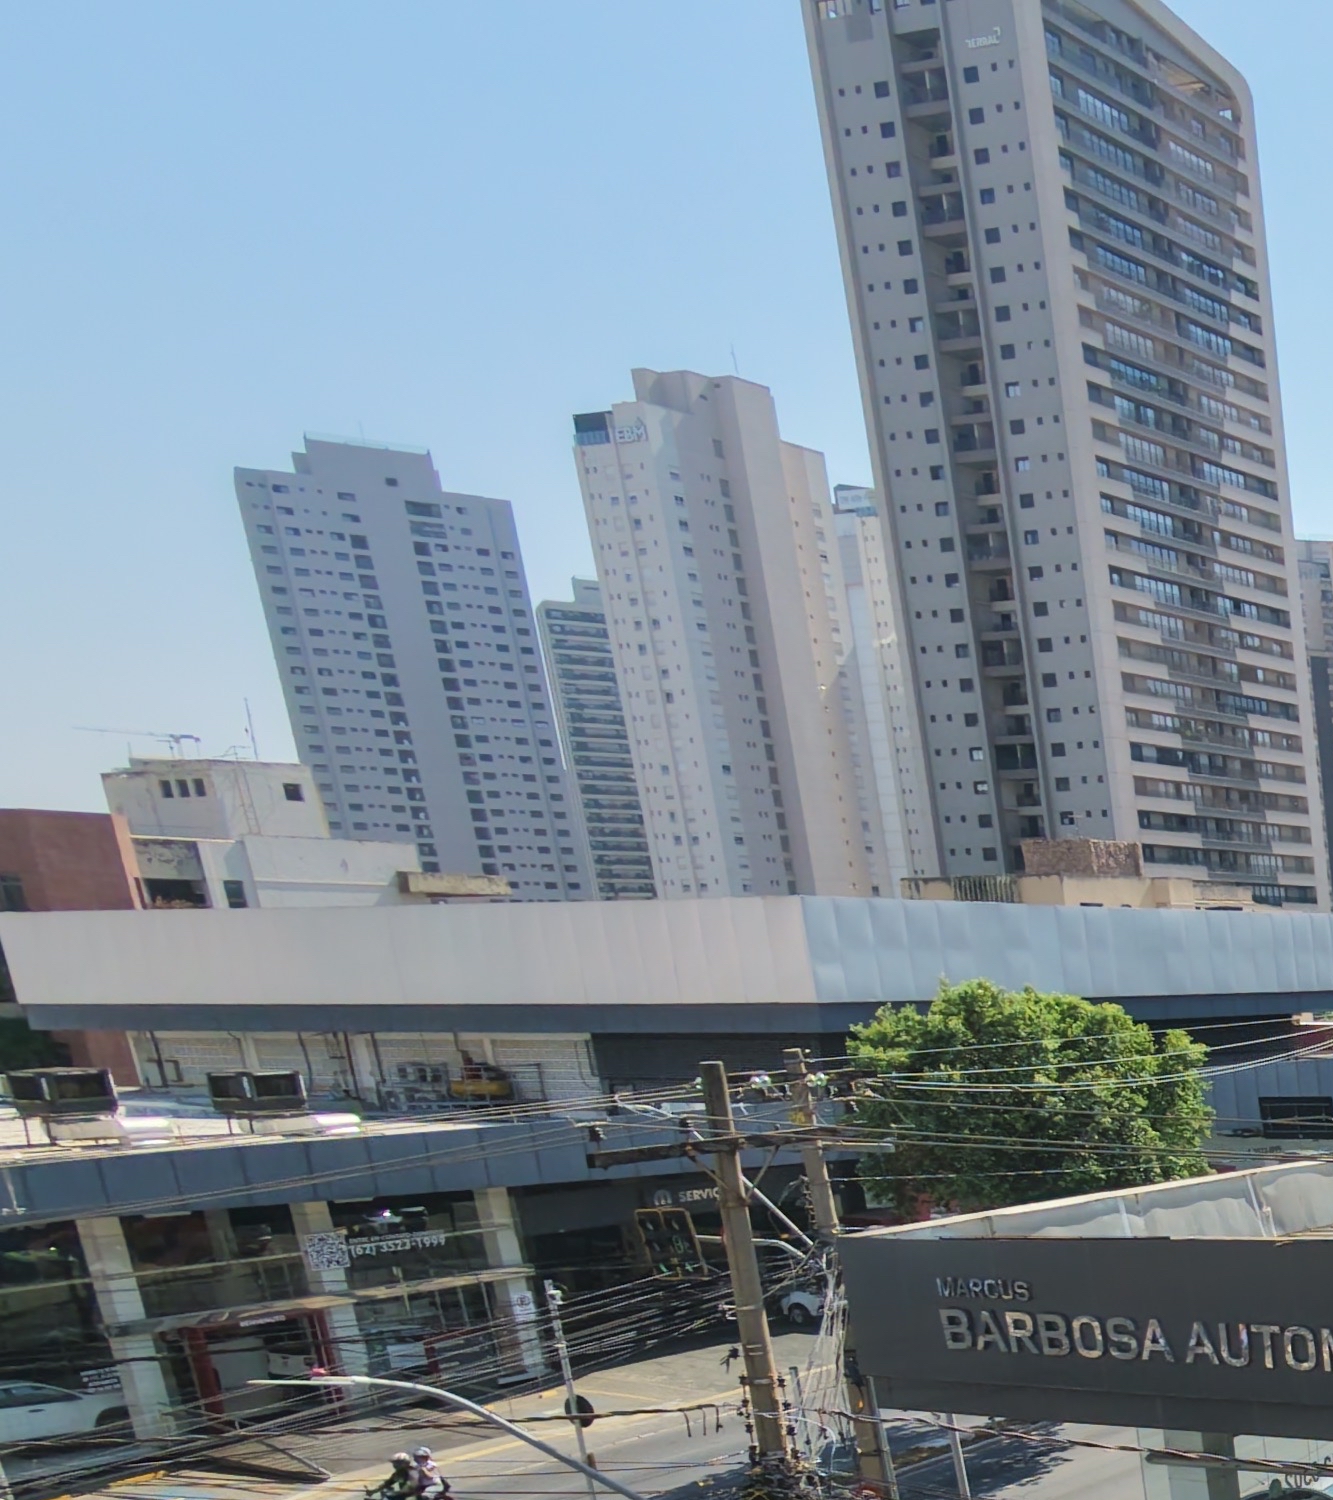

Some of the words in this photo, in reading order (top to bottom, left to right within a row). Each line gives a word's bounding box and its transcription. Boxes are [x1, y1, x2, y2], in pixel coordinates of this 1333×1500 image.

[678, 1187, 720, 1202] SERVIÇ
[936, 1277, 1030, 1301] MARCUS
[939, 1308, 1175, 1363] BARBOSA
